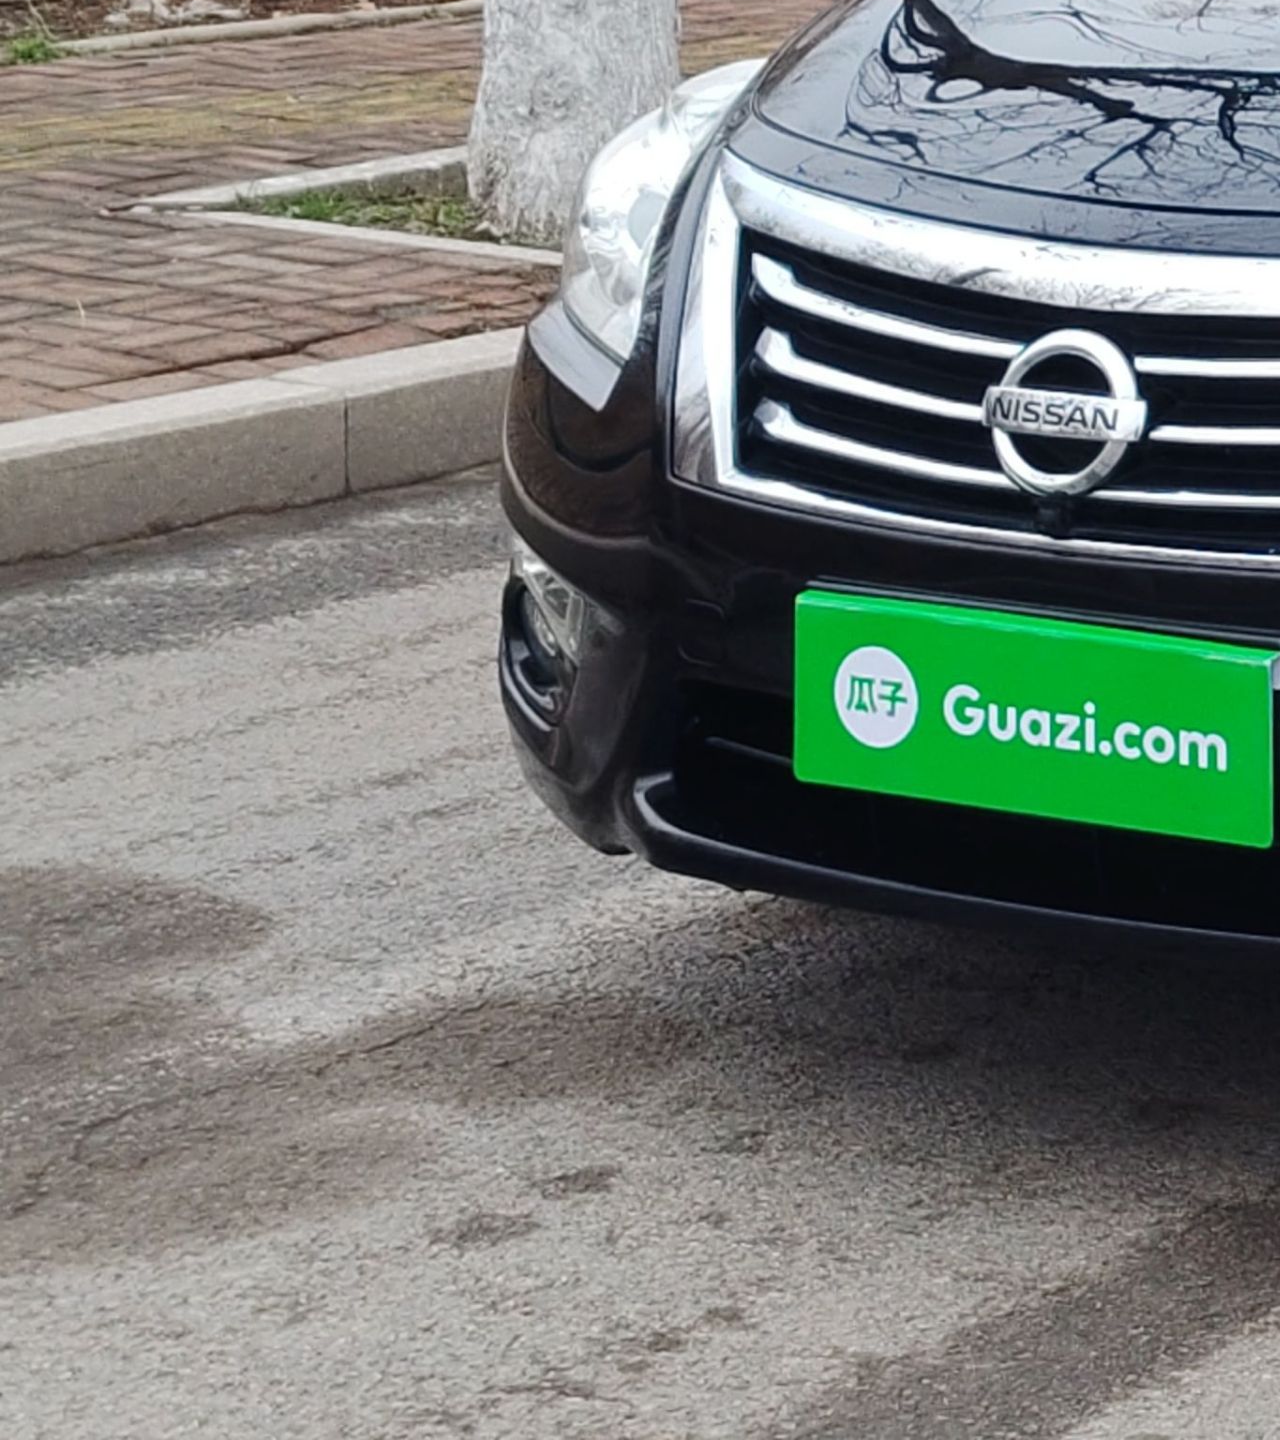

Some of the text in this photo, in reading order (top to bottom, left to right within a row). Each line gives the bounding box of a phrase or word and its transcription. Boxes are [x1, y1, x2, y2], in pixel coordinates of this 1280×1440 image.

[992, 397, 1119, 431] NISSAN
[845, 674, 908, 717] 瓜子
[943, 684, 1228, 772] Guazi.com
